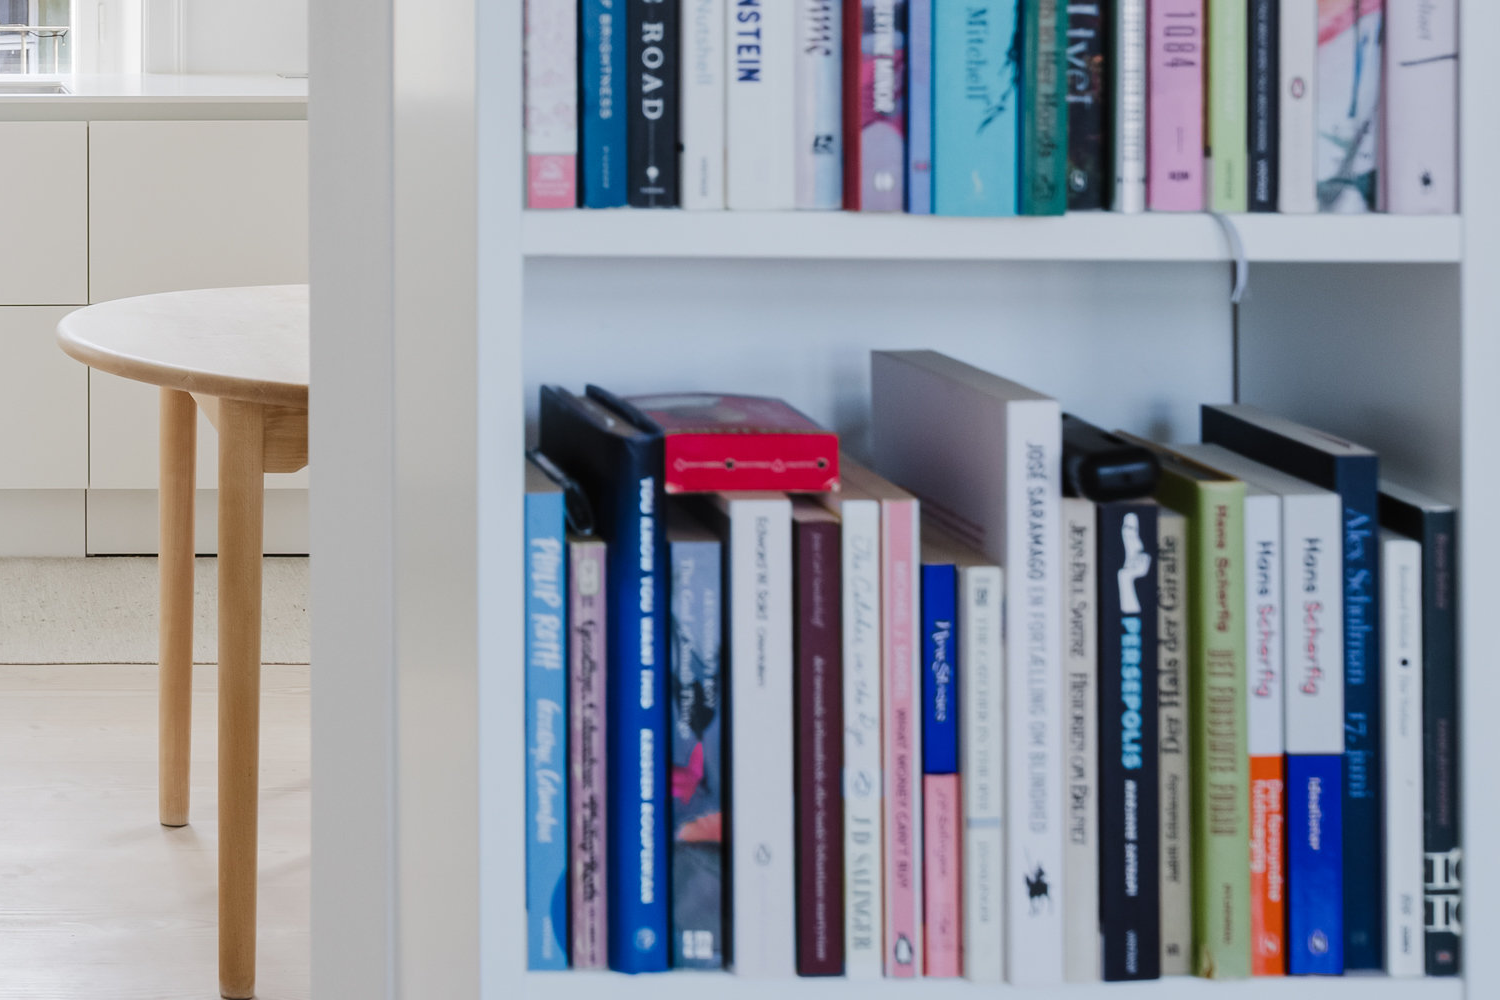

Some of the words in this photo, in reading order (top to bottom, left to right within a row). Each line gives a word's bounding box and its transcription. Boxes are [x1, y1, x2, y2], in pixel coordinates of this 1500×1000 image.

[598, 14, 612, 120] BRIGHTNESS
[966, 7, 990, 101] Mitchell
[1163, 11, 1196, 68] 1Q84
[641, 22, 664, 121] ROAD
[874, 58, 896, 114] MINOR
[1025, 441, 1047, 480] JOSÉ
[639, 477, 654, 514] YOU
[639, 516, 654, 571] KNOW
[1025, 486, 1045, 581] SARAMAGO
[1213, 504, 1228, 549] Hans
[1345, 507, 1369, 562] Alex
[530, 537, 559, 608] PHILIP
[680, 559, 694, 584] The
[1159, 535, 1179, 612] Giraffe
[1254, 540, 1273, 596] Hans
[1301, 537, 1321, 592] Hans
[639, 576, 654, 613] YOU
[680, 587, 694, 614] God
[1027, 585, 1046, 601] EN
[1213, 556, 1231, 632] Scherfig
[531, 613, 559, 670] ROTH
[639, 616, 654, 666] WANT
[1068, 601, 1088, 658] SARTRE
[1159, 620, 1179, 654] der
[1252, 603, 1275, 697] Scherfig
[1299, 602, 1323, 695] Scherfig
[1345, 568, 1370, 685] Schulman
[639, 670, 654, 709] THIS
[680, 642, 694, 685] Small
[1159, 661, 1180, 709] Hals
[677, 688, 693, 740] Things
[1120, 616, 1142, 770] PERSEPOLIS
[894, 708, 908, 749] WHAT
[1027, 720, 1046, 746] OM
[1159, 718, 1180, 755] Der
[894, 755, 908, 807] MONEY
[1027, 752, 1046, 833] BLINDHED
[1345, 750, 1373, 799] juni
